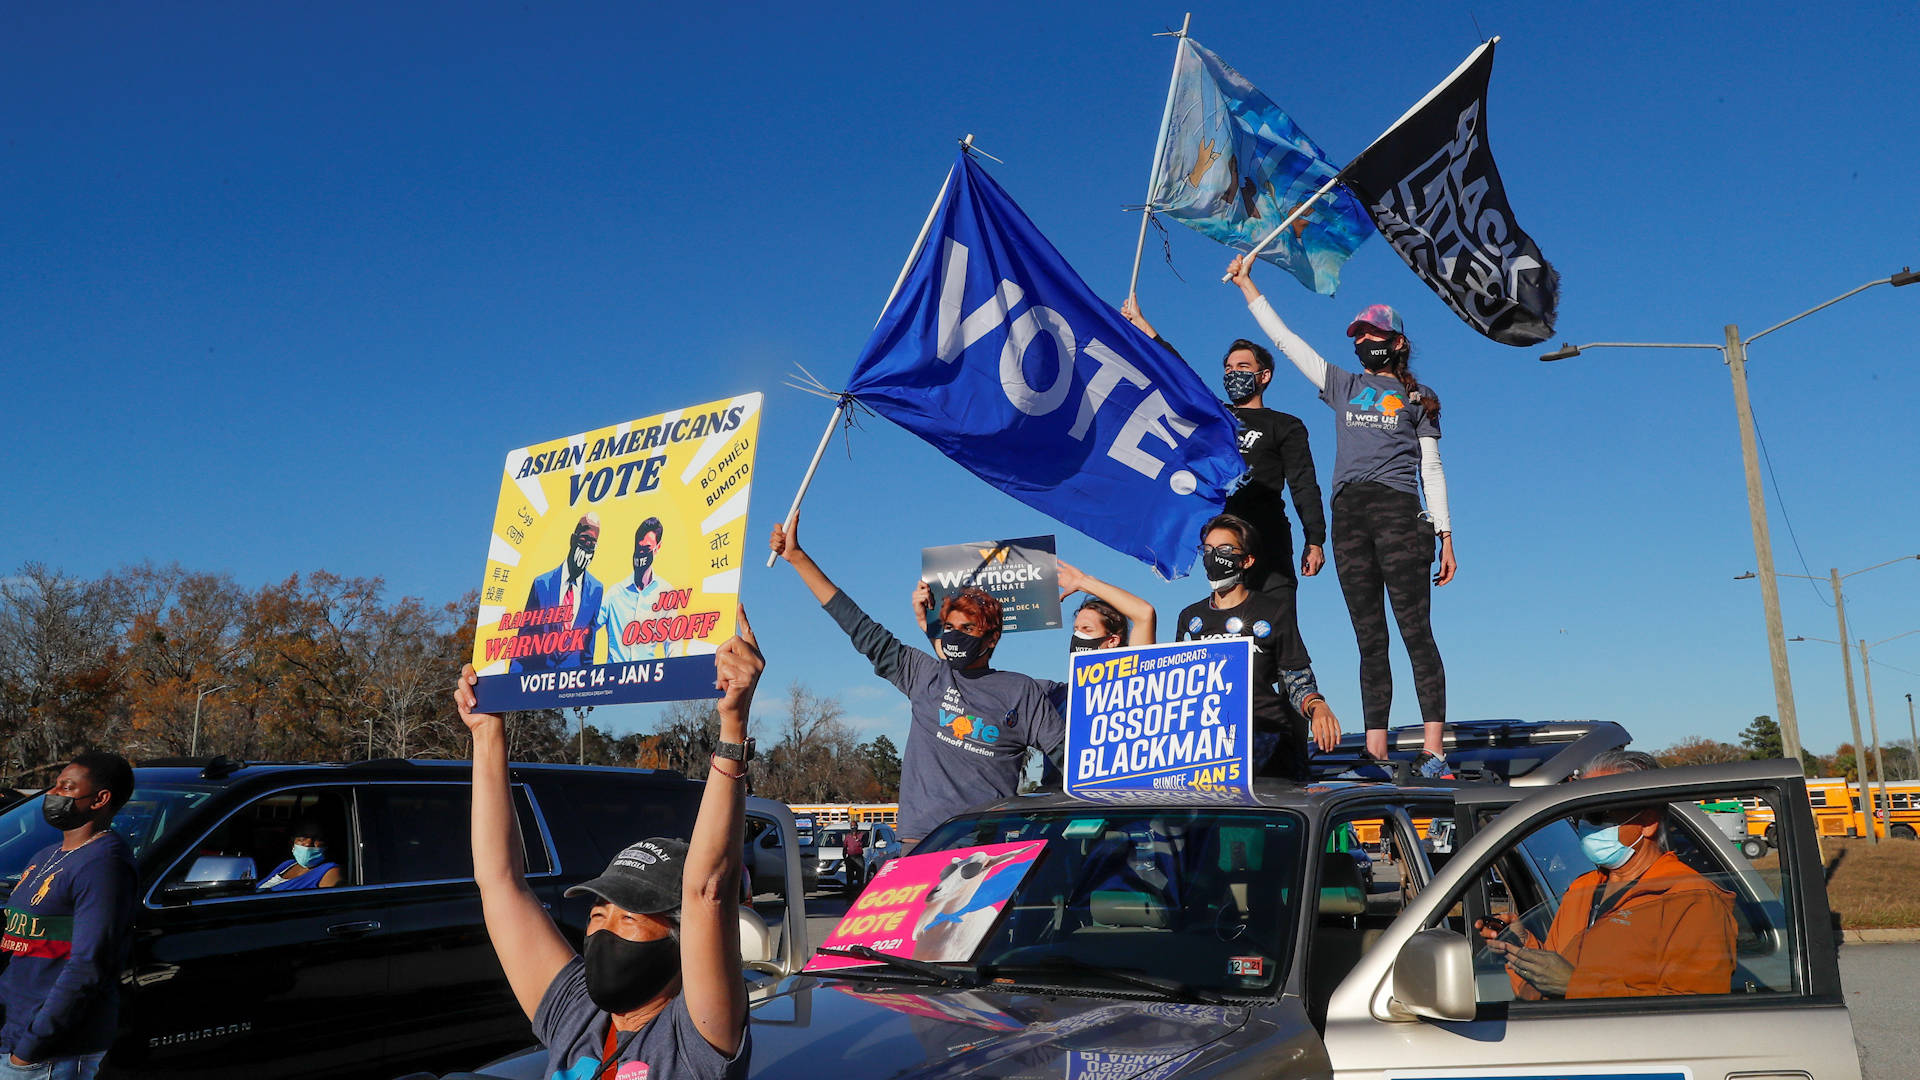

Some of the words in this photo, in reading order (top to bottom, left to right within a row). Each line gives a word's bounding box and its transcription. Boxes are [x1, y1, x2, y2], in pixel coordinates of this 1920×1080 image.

[1370, 348, 1388, 356] VOTE
[1345, 411, 1354, 421] It
[1354, 414, 1379, 422] was
[1381, 414, 1400, 424] us!
[515, 441, 590, 480] ASIAN
[586, 405, 745, 463] AMERICANS
[569, 454, 668, 507] VOTE
[705, 462, 750, 507] BUMOTO
[1215, 555, 1233, 568] VOTE
[936, 564, 1043, 589] Warnock
[990, 582, 1025, 592] SENATE
[651, 588, 693, 612] JON
[497, 604, 575, 631] RAPHAEL
[621, 611, 720, 647] OSSOFF
[485, 627, 590, 662] WARNOCK
[520, 672, 556, 693] VOTE
[558, 669, 587, 690] DEC
[590, 667, 605, 687] 14
[618, 663, 651, 685] JAN
[653, 662, 664, 682] 5
[1076, 654, 1140, 687] VOTE!
[1139, 660, 1155, 673] FOR
[1157, 648, 1207, 668] DEMOCRATS
[943, 693, 954, 702] do
[1085, 659, 1233, 716] WARNOCK,
[1089, 698, 1197, 746] OSSOFF
[1200, 694, 1222, 727] &
[936, 731, 963, 748] Runoff
[963, 743, 995, 757] Election
[1077, 724, 1237, 781] BLACKMAN
[1187, 765, 1227, 787] JAN
[1228, 763, 1241, 780] 5
[857, 883, 929, 911] GOAT
[837, 910, 908, 938] VOTE
[870, 938, 903, 951] 2021
[1231, 961, 1241, 972] 12
